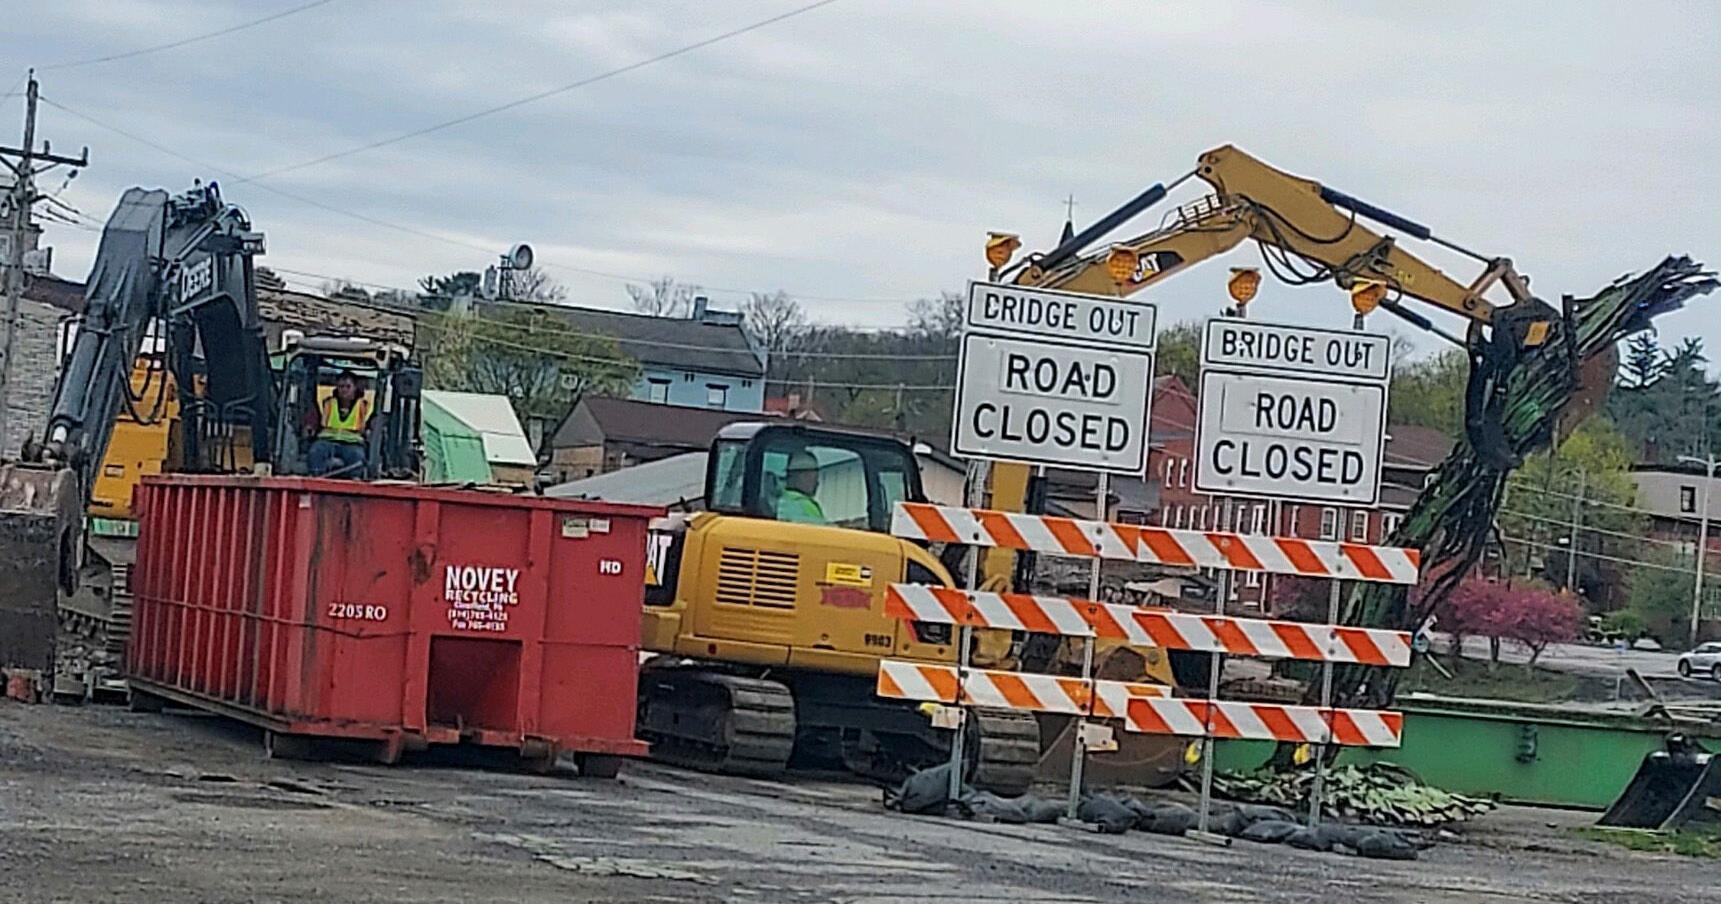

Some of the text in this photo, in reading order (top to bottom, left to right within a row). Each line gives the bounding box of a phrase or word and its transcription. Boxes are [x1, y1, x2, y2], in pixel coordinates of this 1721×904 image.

[181, 256, 211, 303] DEERE
[984, 293, 1140, 337] BRIDGE OUT
[1222, 329, 1375, 370] BRIDGE OUT
[1006, 353, 1117, 399] ROAD
[972, 402, 1130, 452] CLOSED
[1255, 392, 1337, 433] ROAD
[1212, 439, 1364, 485] CLOSED
[446, 565, 519, 593] NOVEY
[646, 531, 673, 587] AT
[445, 589, 518, 605] RECYCLING
